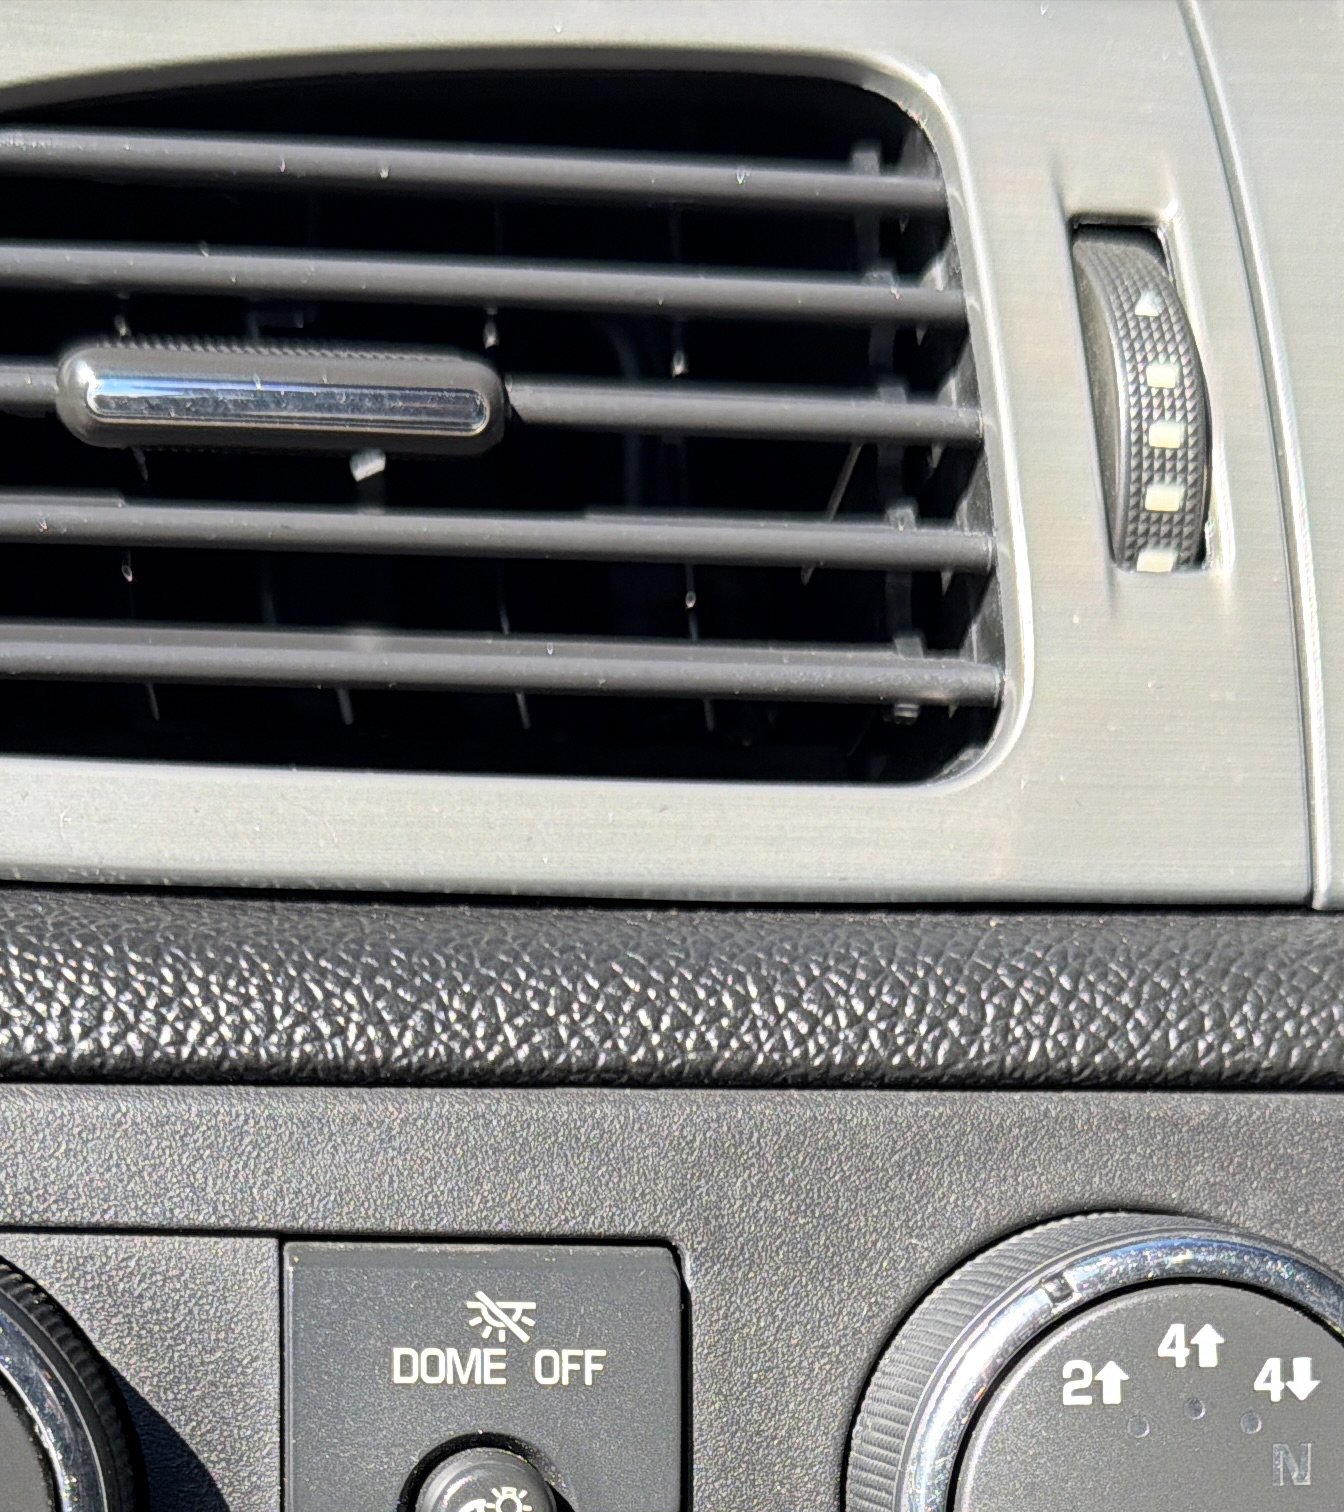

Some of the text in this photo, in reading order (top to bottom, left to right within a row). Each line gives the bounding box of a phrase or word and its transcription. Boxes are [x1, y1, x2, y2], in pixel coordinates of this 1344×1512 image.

[391, 1347, 607, 1385] DOME OFF
[1157, 1323, 1190, 1369] 4
[1061, 1360, 1094, 1406] 2
[1253, 1357, 1285, 1403] 4
[1271, 1442, 1312, 1487] N
